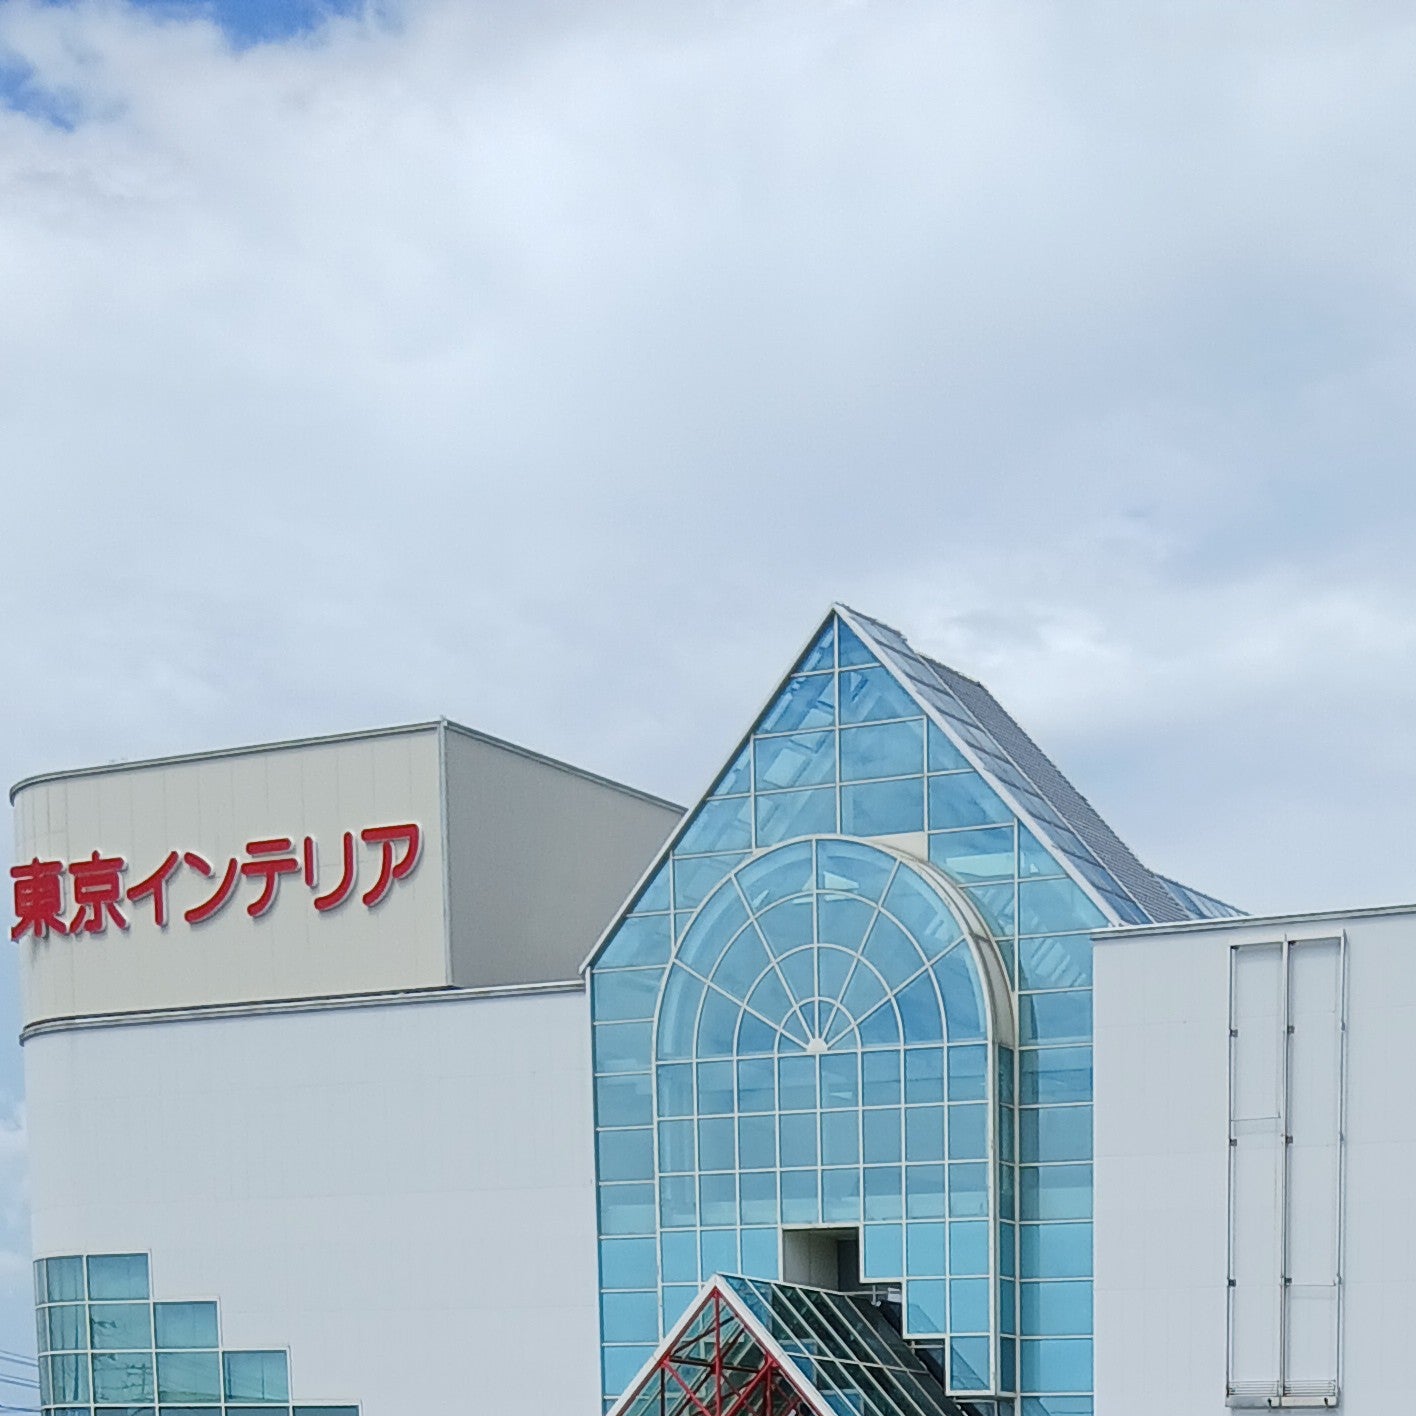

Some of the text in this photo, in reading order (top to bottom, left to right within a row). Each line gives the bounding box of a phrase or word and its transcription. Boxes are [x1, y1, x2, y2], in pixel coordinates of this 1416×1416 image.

[10, 823, 421, 941] 東京インテリア
